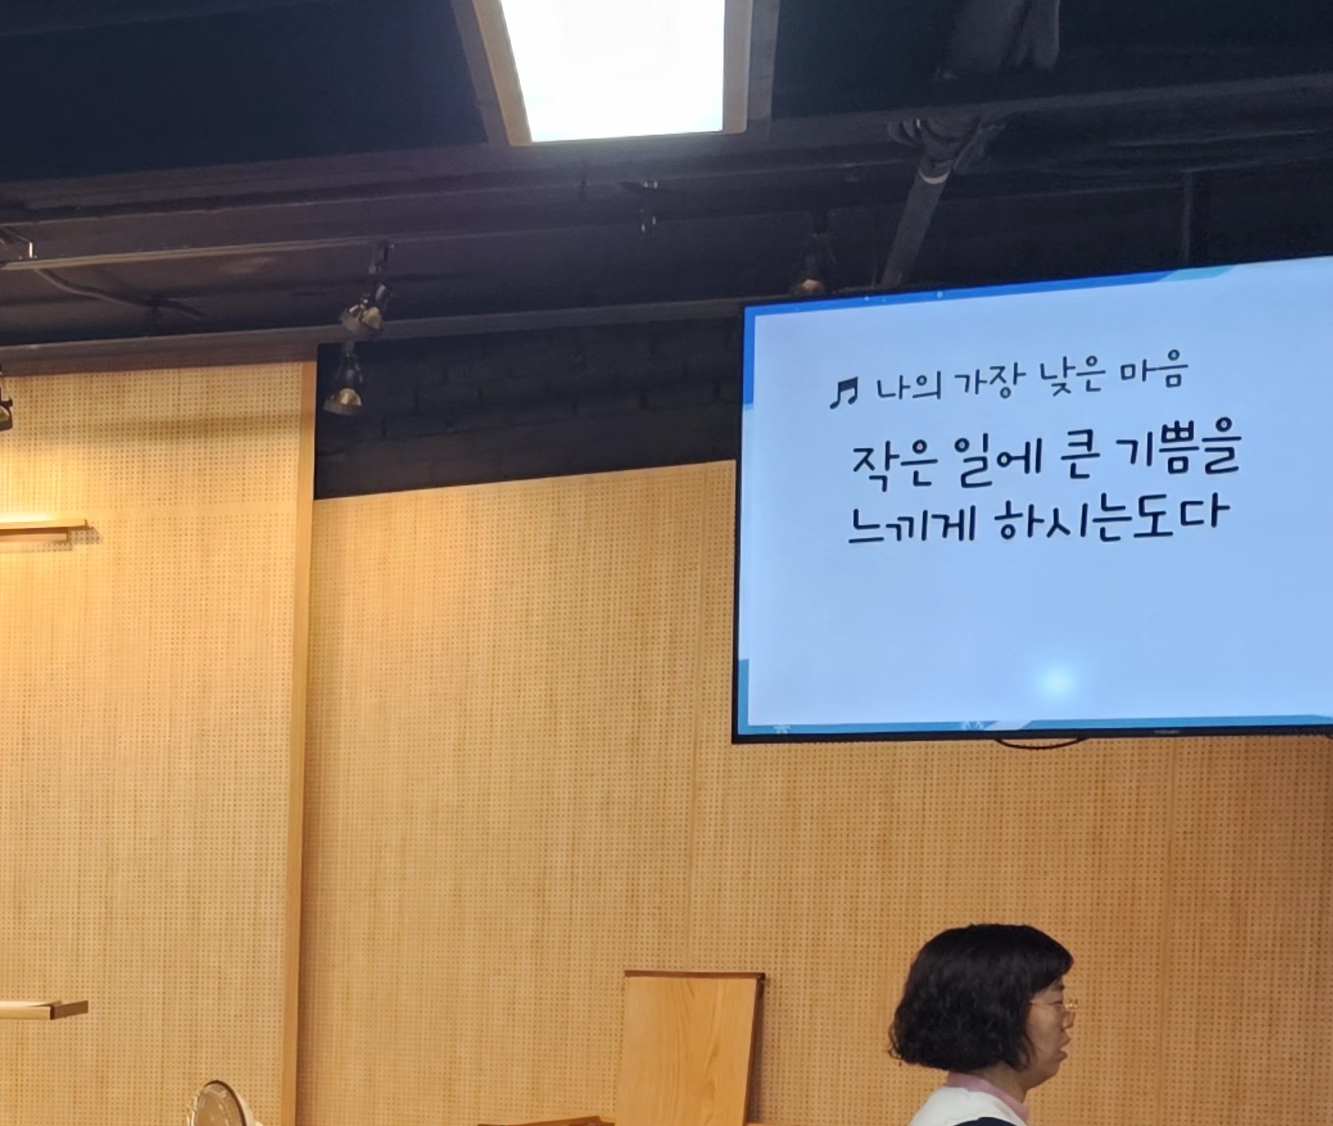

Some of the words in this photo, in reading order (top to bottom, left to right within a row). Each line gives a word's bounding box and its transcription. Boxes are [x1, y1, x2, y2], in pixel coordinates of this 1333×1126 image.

[876, 370, 942, 400] 나의
[954, 361, 1027, 399] 가장
[1039, 355, 1106, 397] 낮은
[1120, 349, 1189, 389] 마음
[852, 438, 939, 493] 작은
[954, 432, 1043, 489] 일에
[1060, 428, 1101, 480] 큰
[1115, 416, 1243, 475] 기쁨을
[848, 504, 976, 544] 느끼게
[993, 491, 1231, 543] 하시는도다
